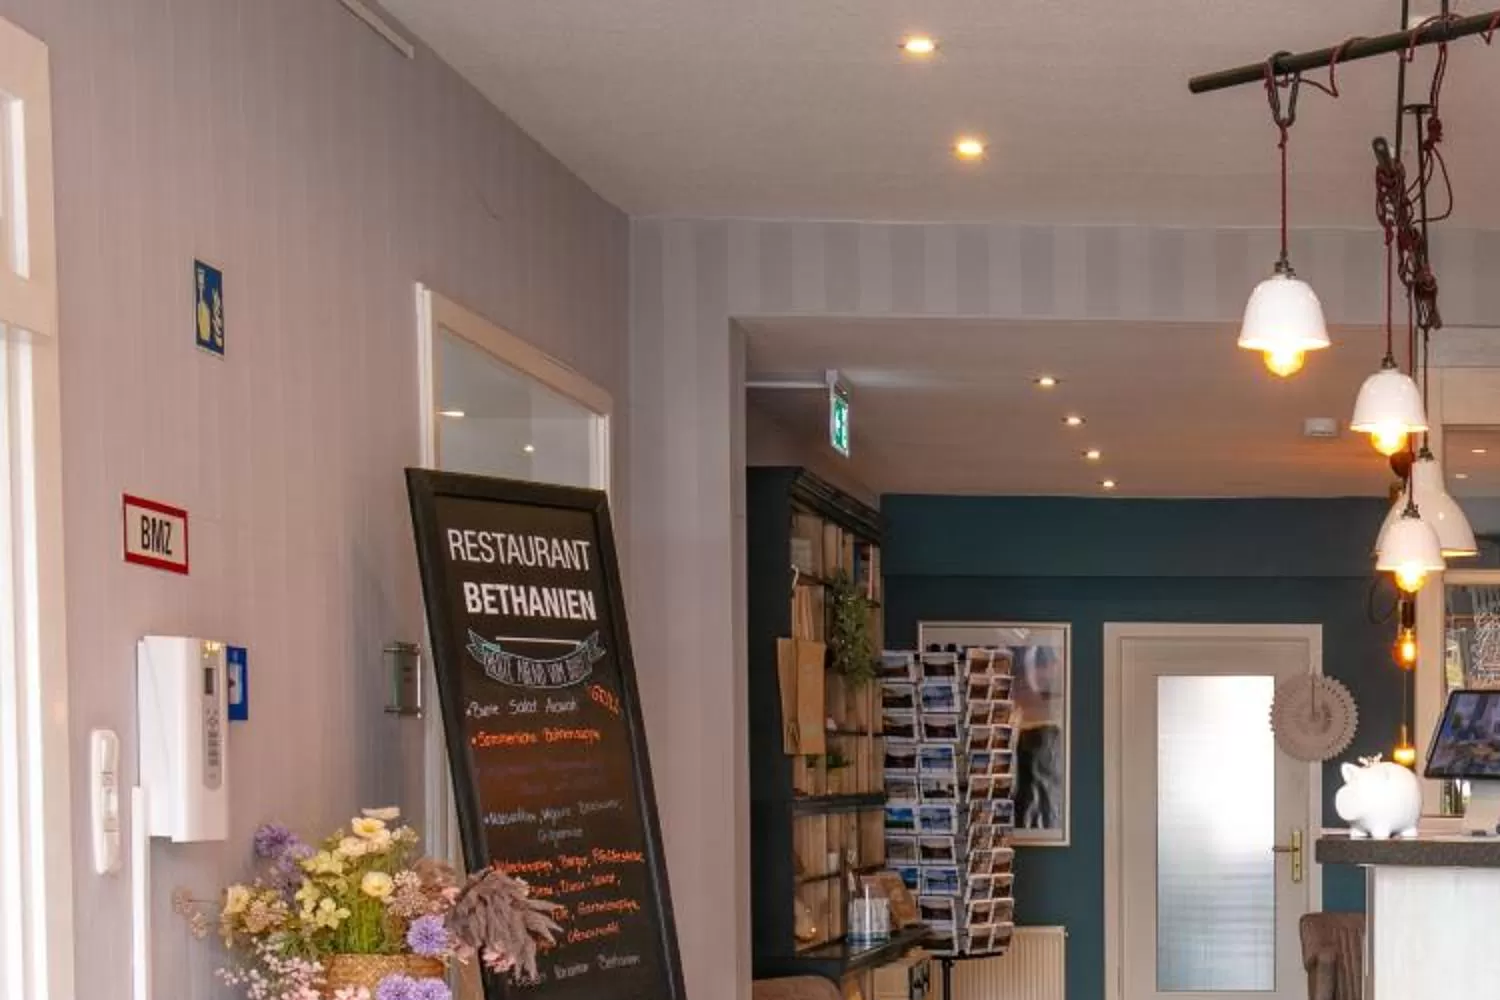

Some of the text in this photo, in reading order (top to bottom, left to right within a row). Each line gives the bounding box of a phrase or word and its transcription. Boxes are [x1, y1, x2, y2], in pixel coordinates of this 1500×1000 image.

[141, 515, 172, 555] BMZ
[447, 528, 591, 571] RESTAURANT
[463, 581, 597, 620] BETHANIEN
